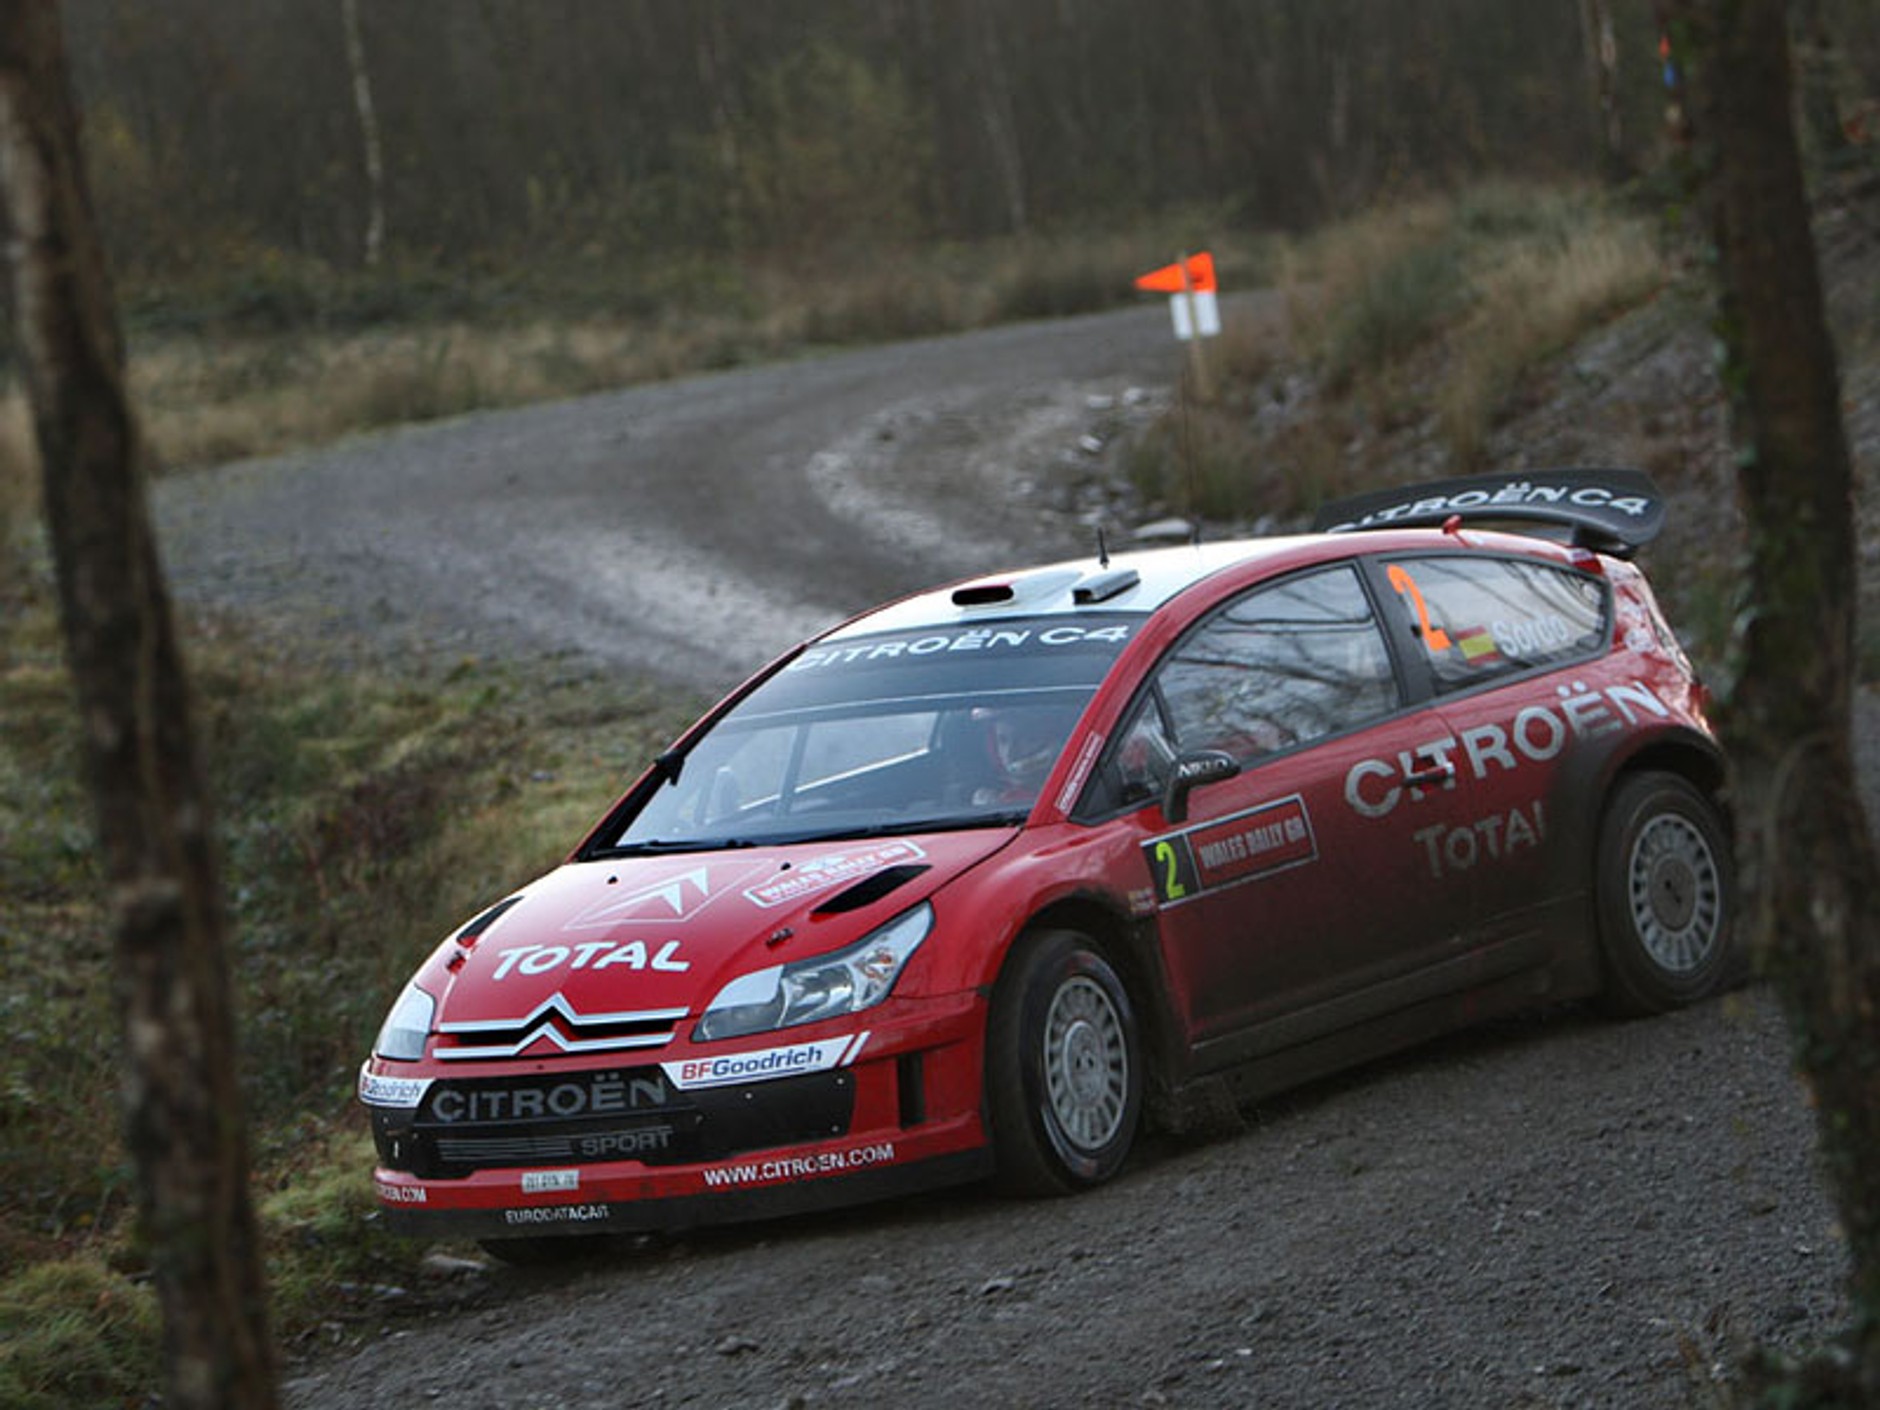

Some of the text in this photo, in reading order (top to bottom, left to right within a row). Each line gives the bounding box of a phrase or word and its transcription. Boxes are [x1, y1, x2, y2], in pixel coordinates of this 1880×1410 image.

[1571, 488, 1649, 516] C4
[1387, 564, 1452, 652] 2
[789, 624, 1129, 672] CITROËN C4
[1343, 680, 1670, 818] CITROËN
[1156, 841, 1185, 899] 2
[492, 939, 692, 980] TOTAL
[681, 1045, 823, 1080] BFGoodrich
[430, 1071, 668, 1123] CITROËN
[580, 1129, 671, 1158] SPORT
[703, 1144, 895, 1187] WWW.CITROEN.COM
